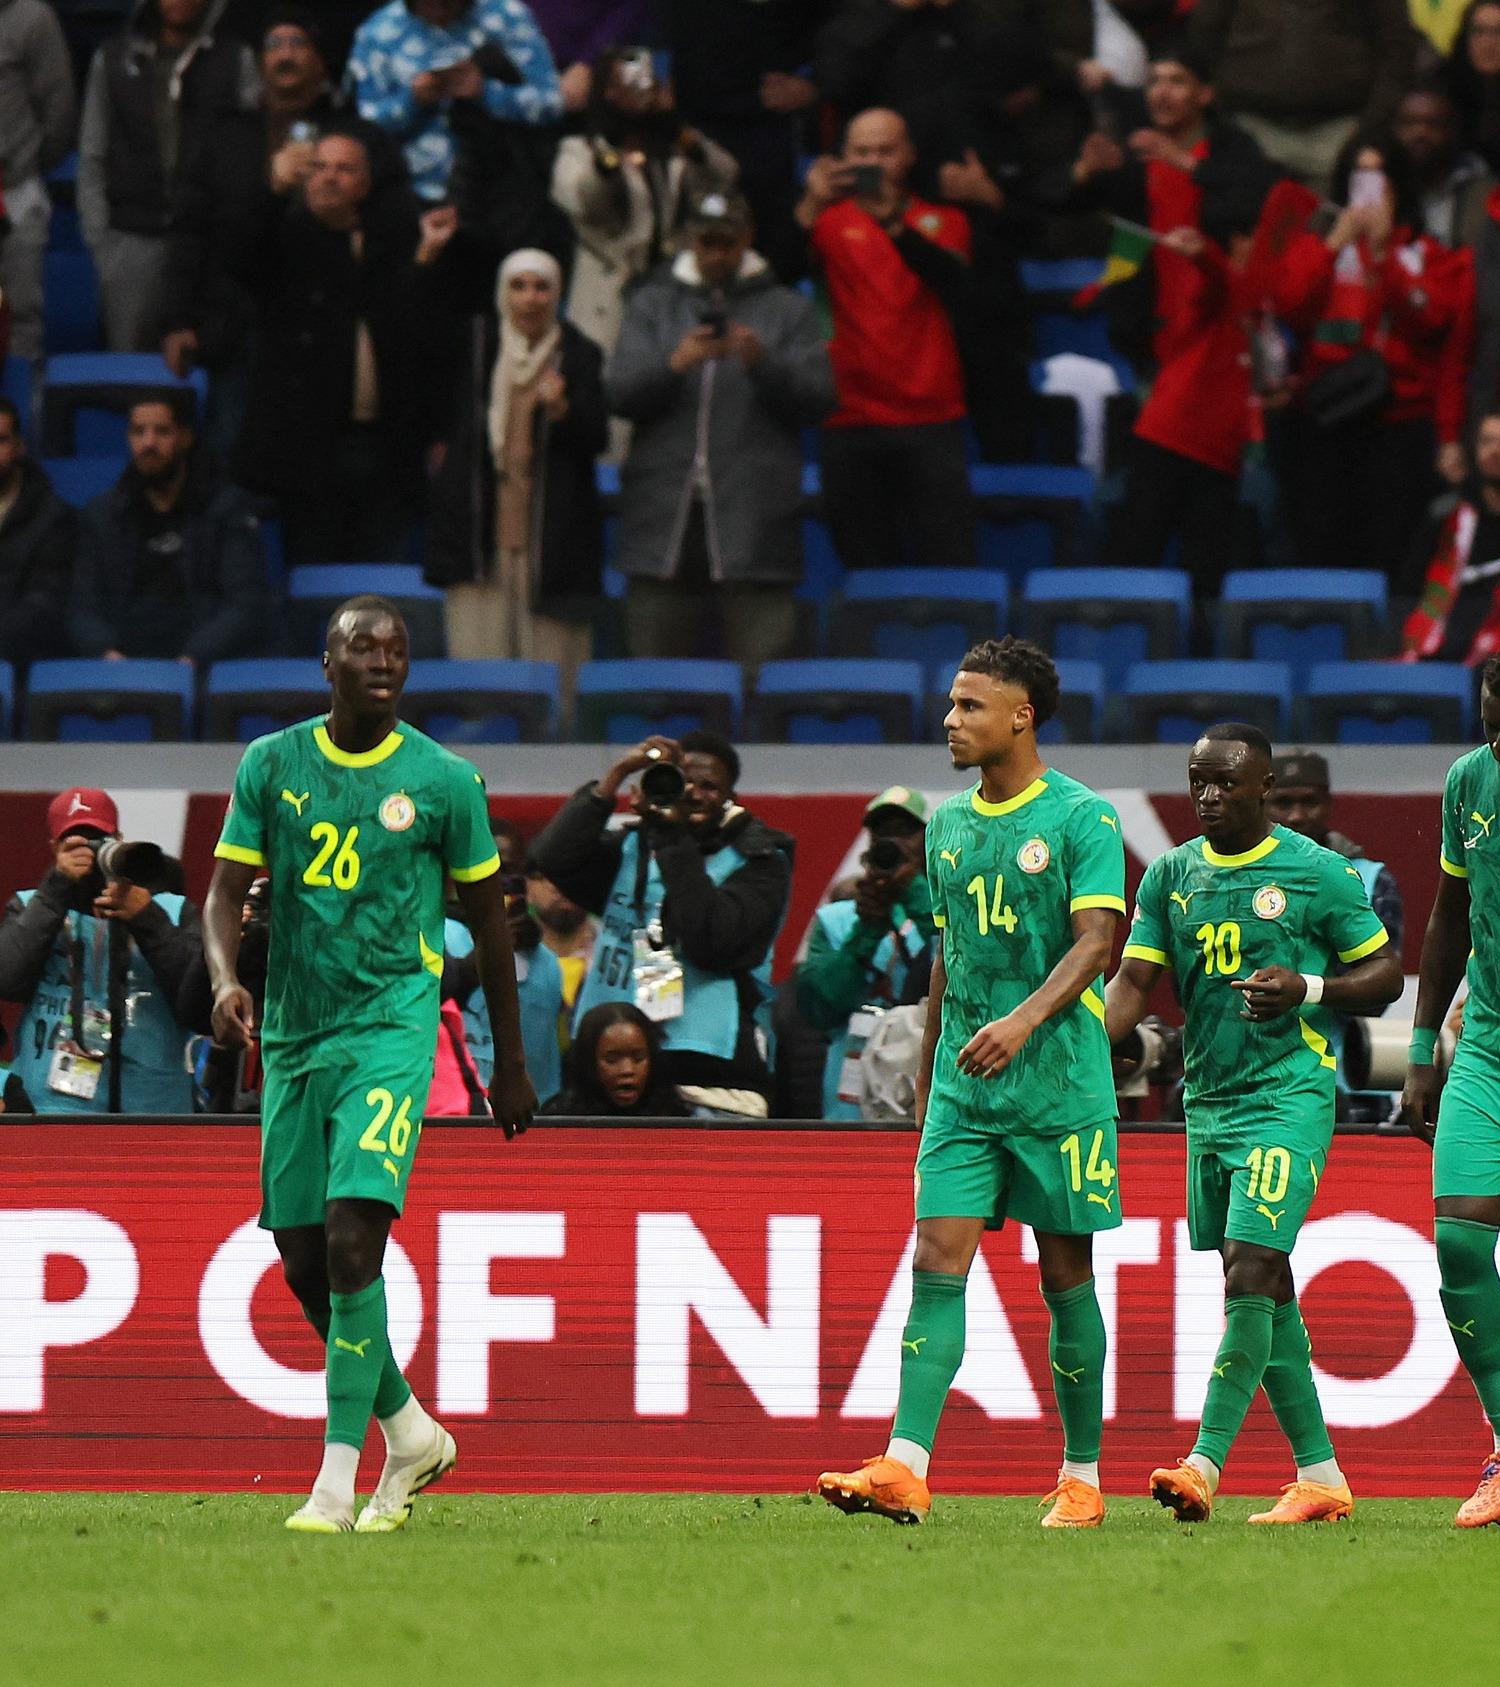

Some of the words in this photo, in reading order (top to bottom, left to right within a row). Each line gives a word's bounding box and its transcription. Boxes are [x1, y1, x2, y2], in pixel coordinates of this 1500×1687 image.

[302, 821, 360, 891] 26
[967, 874, 1018, 936] 14
[1196, 921, 1242, 975] 10
[358, 1087, 412, 1157] 26
[1060, 1129, 1116, 1193] 14
[1246, 1147, 1291, 1203] 10
[0, 1208, 140, 1413] P
[197, 1207, 567, 1419] OF
